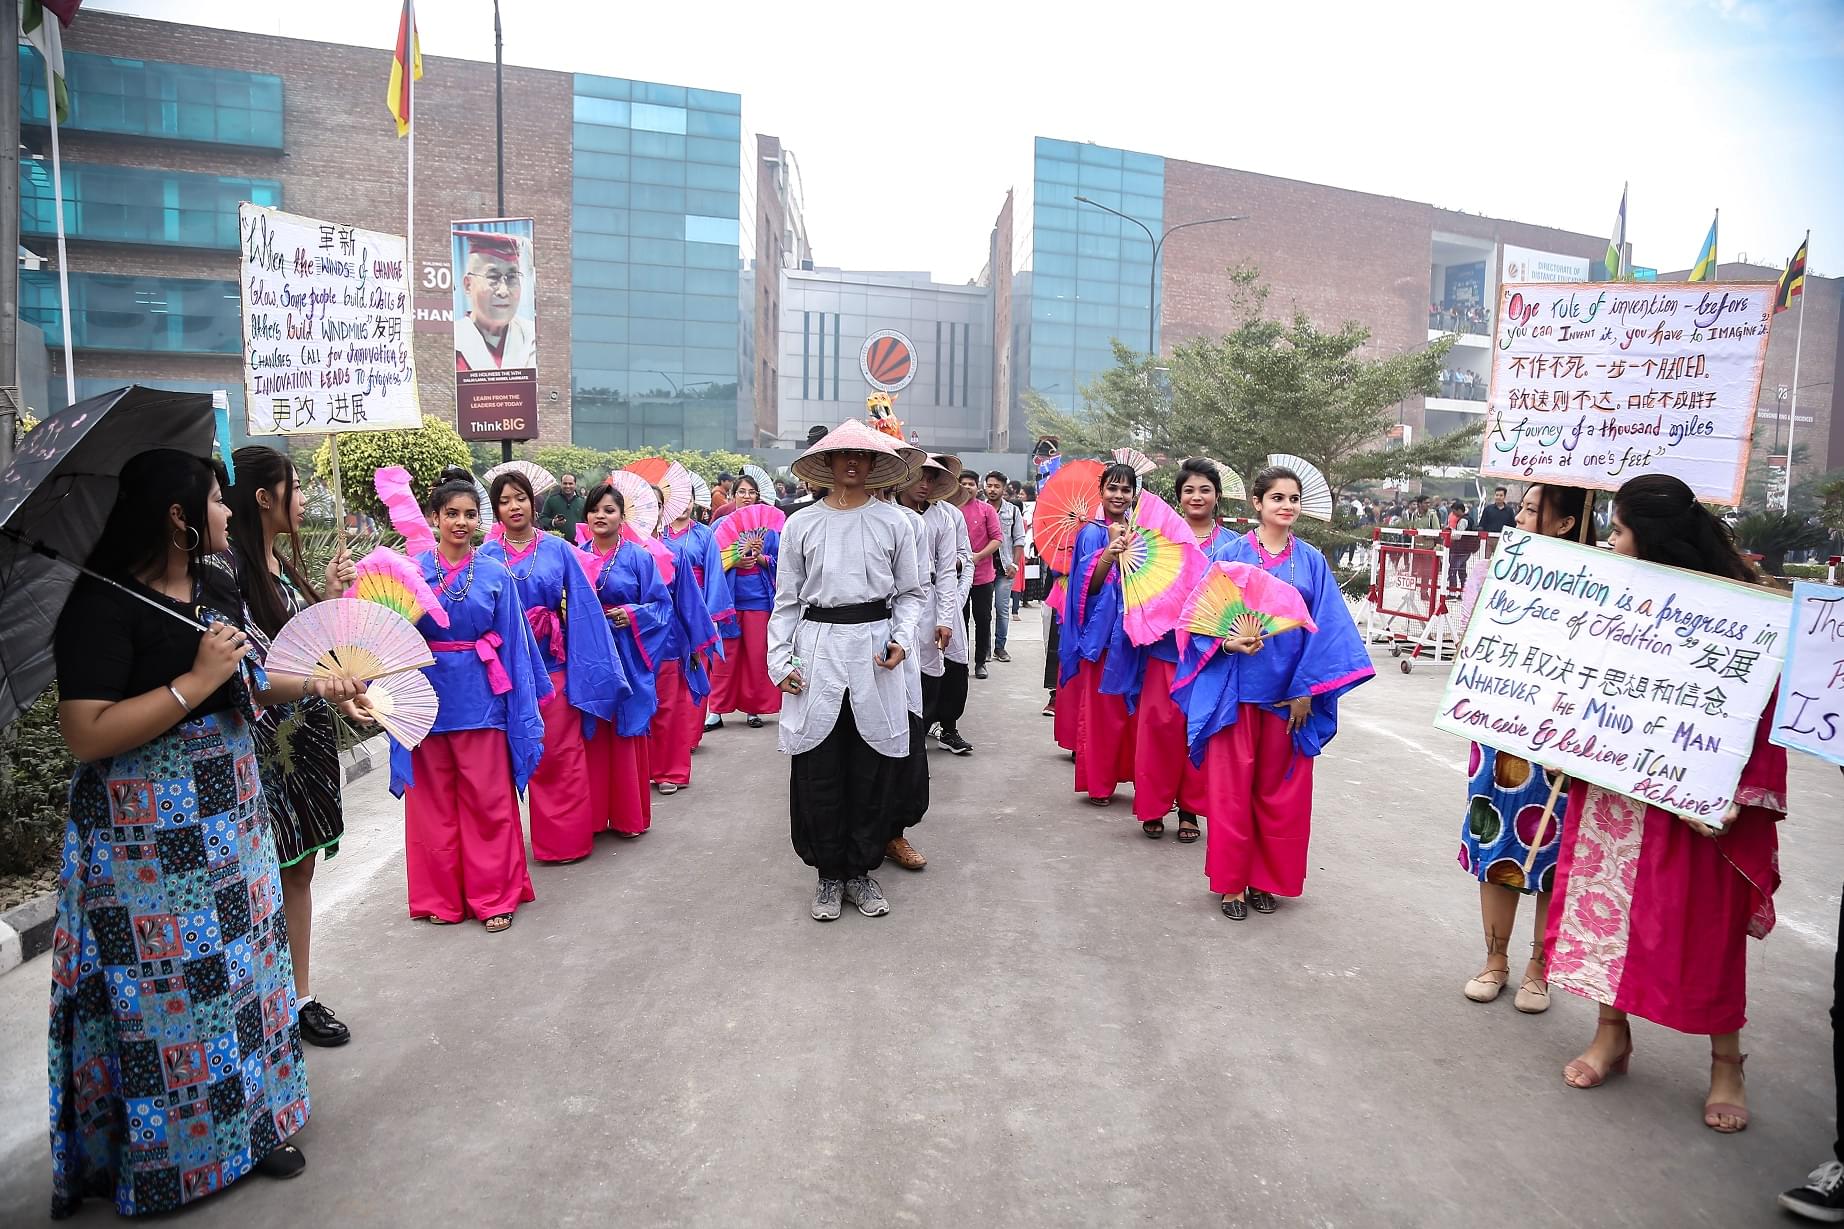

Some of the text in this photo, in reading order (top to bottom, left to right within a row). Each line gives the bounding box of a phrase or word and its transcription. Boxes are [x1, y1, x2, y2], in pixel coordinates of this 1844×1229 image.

[319, 224, 355, 257] 革新
[293, 248, 314, 278] the
[358, 248, 369, 289] of
[373, 260, 403, 282] CHANGE
[423, 267, 451, 289] 30
[1531, 270, 1556, 282] DISTANCE
[1538, 262, 1572, 274] DIRECTORATE
[280, 283, 307, 315] Some
[306, 287, 337, 321] people
[1551, 293, 1580, 318] rule
[1579, 292, 1606, 323] of
[1608, 294, 1679, 326] invention
[1694, 292, 1749, 328] before
[286, 313, 313, 340] build
[372, 314, 402, 343] 发明
[1499, 326, 1528, 350] you
[1532, 326, 1552, 338] can
[1620, 328, 1648, 350] you
[1647, 320, 1683, 346] have
[1690, 328, 1704, 344] to
[301, 345, 321, 366] CALL
[326, 345, 343, 369] for
[320, 368, 350, 389] LEADS
[270, 393, 368, 433] 更改 进展
[1562, 415, 1586, 451] of
[1587, 424, 1595, 436] a
[1599, 414, 1662, 441] thousand
[1668, 414, 1714, 446] miles
[1512, 446, 1553, 476] begins
[1559, 452, 1572, 466] at
[1584, 450, 1615, 466] one's
[1397, 576, 1415, 588] STOP
[1485, 589, 1521, 616] the
[1490, 598, 1560, 624] face
[1566, 610, 1588, 640] of
[1615, 587, 1634, 612] is
[1634, 598, 1652, 616] a
[1656, 593, 1748, 640] progress
[1752, 623, 1778, 654] in
[1690, 643, 1761, 684] 发展
[1552, 691, 1576, 716] THE
[1672, 722, 1722, 753] MAN
[1778, 691, 1840, 741] Is
[1442, 698, 1529, 736] Conceive
[1549, 728, 1629, 772] believe,
